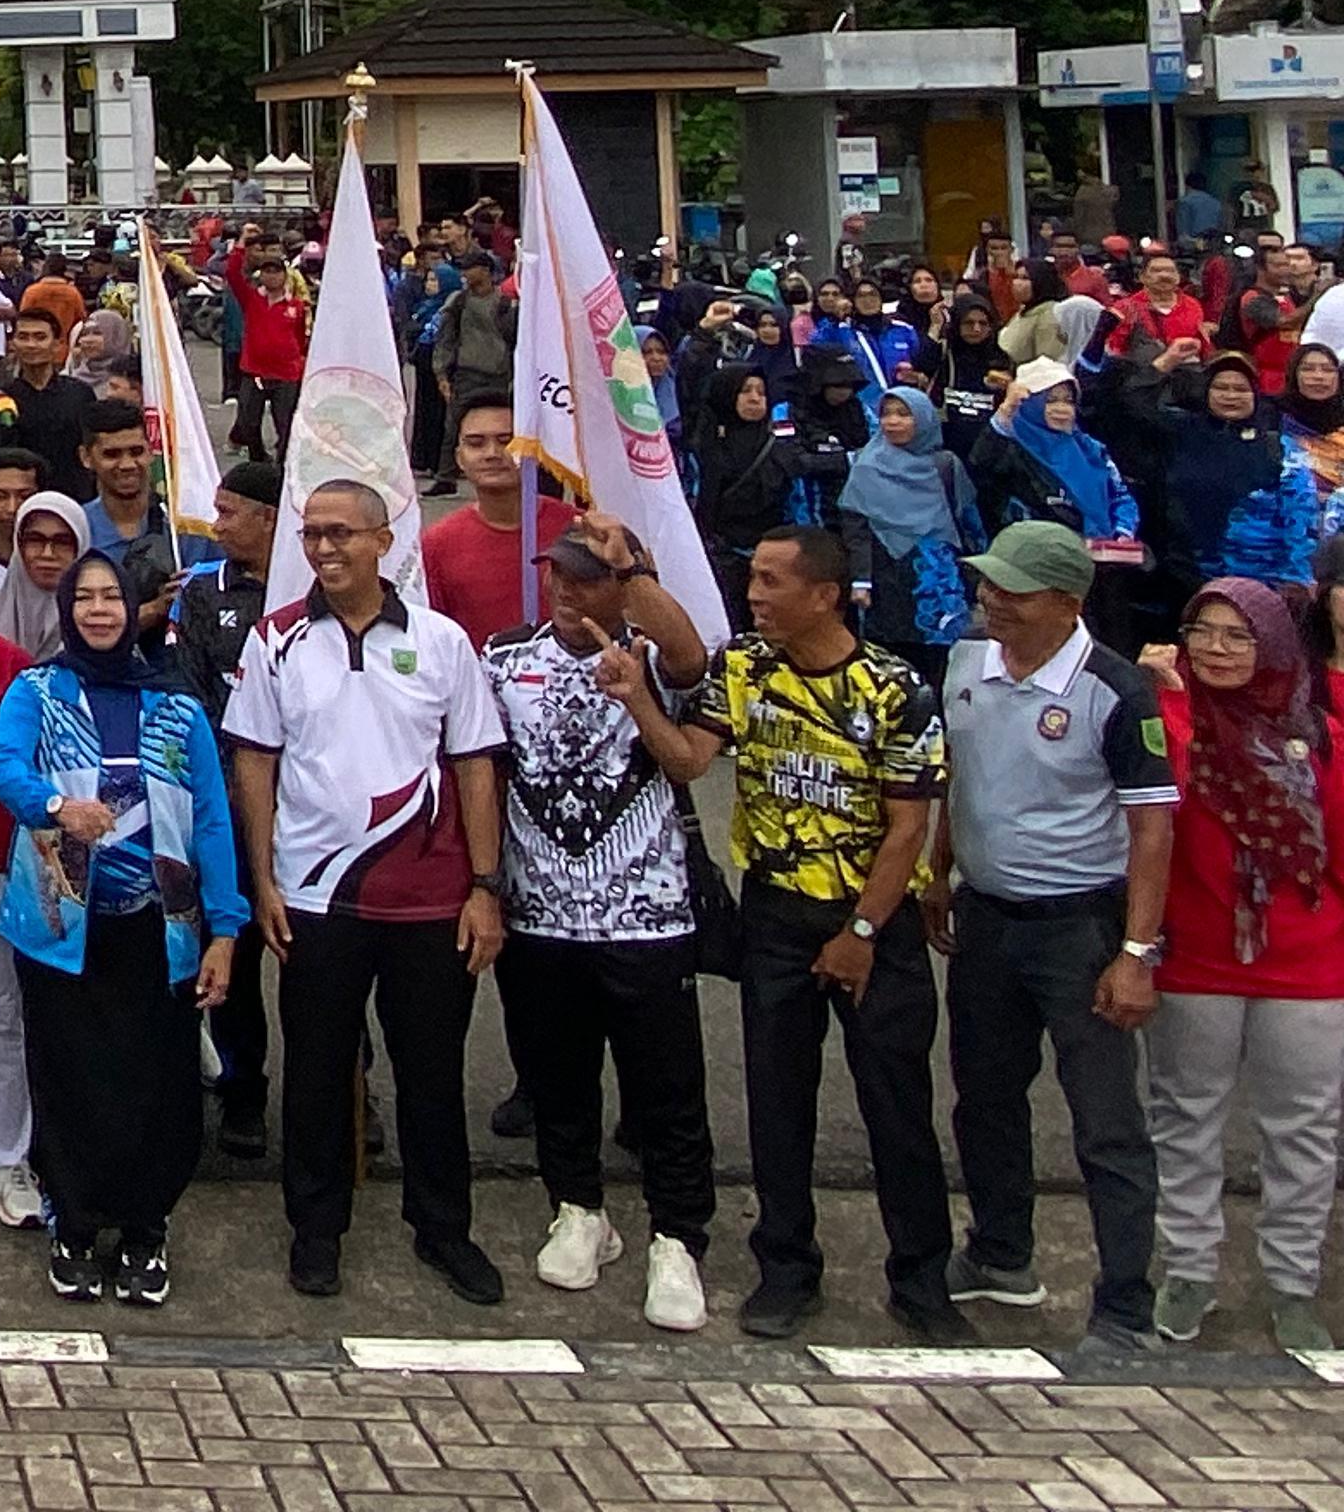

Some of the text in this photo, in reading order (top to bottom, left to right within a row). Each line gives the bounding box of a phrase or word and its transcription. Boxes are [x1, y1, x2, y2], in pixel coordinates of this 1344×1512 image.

[539, 373, 575, 415] EC.
[766, 771, 853, 811] THE GAME
